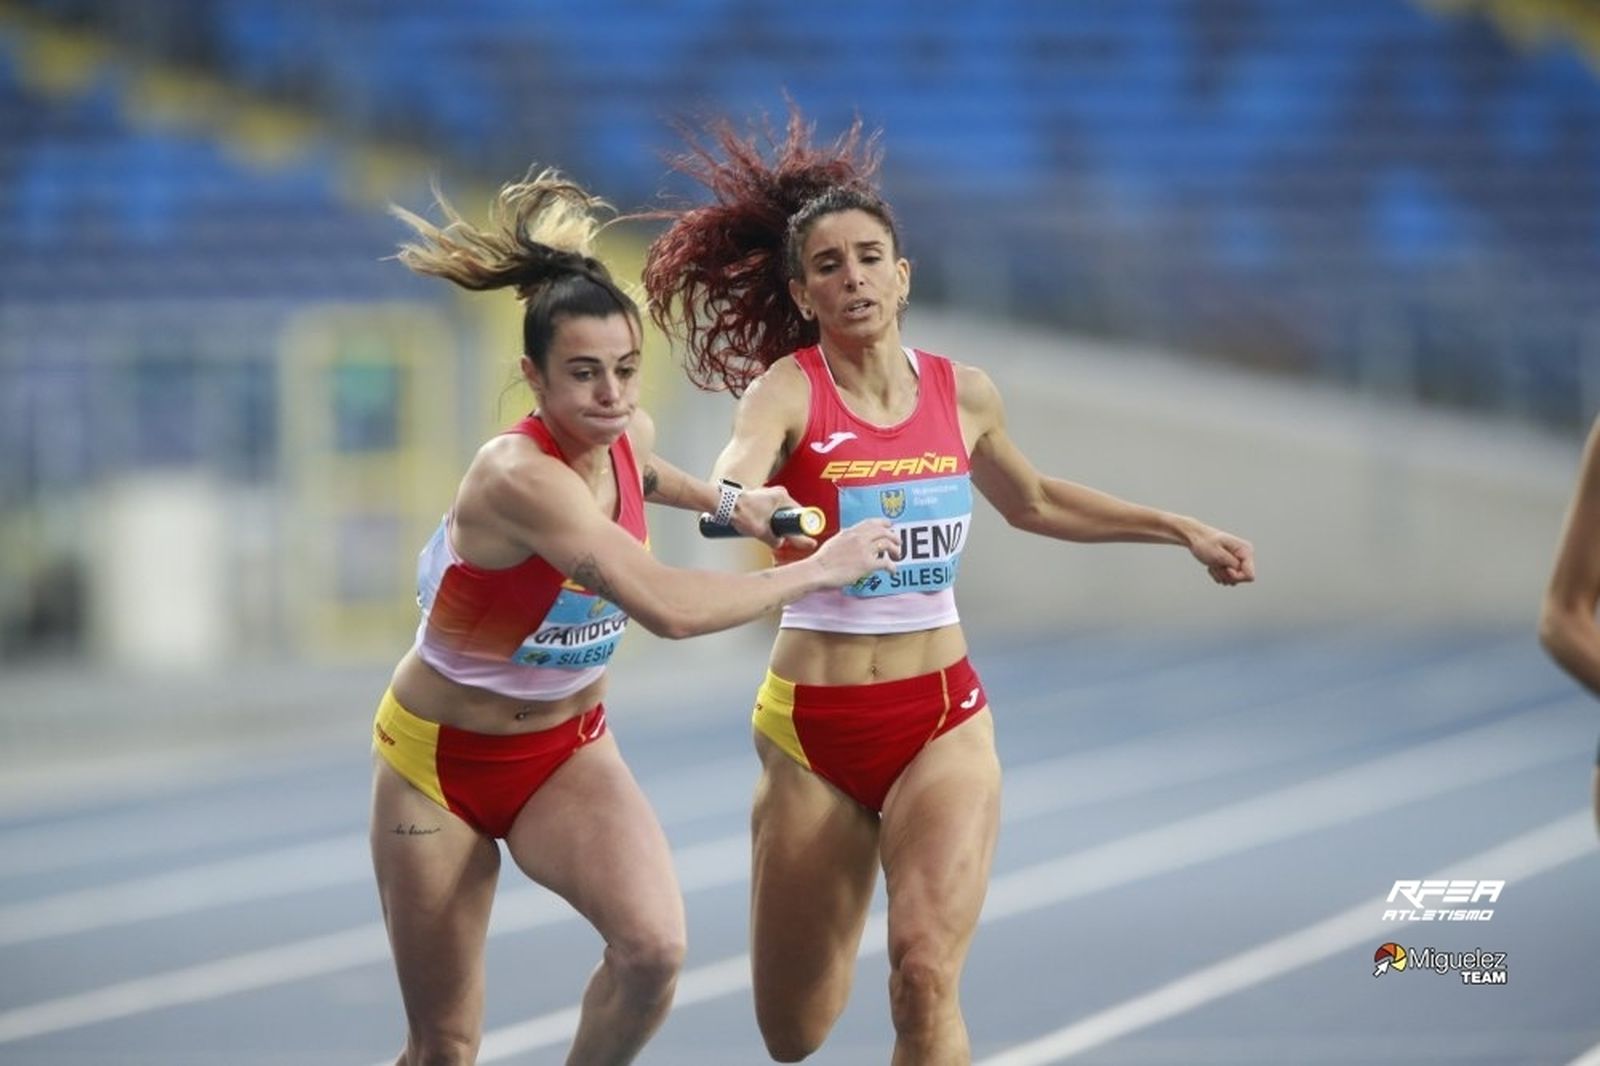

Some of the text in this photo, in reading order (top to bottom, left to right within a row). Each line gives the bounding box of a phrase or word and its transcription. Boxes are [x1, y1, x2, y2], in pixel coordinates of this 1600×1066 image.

[819, 452, 958, 480] ESPAÑA
[877, 521, 963, 562] UENO
[890, 567, 953, 588] SILESI
